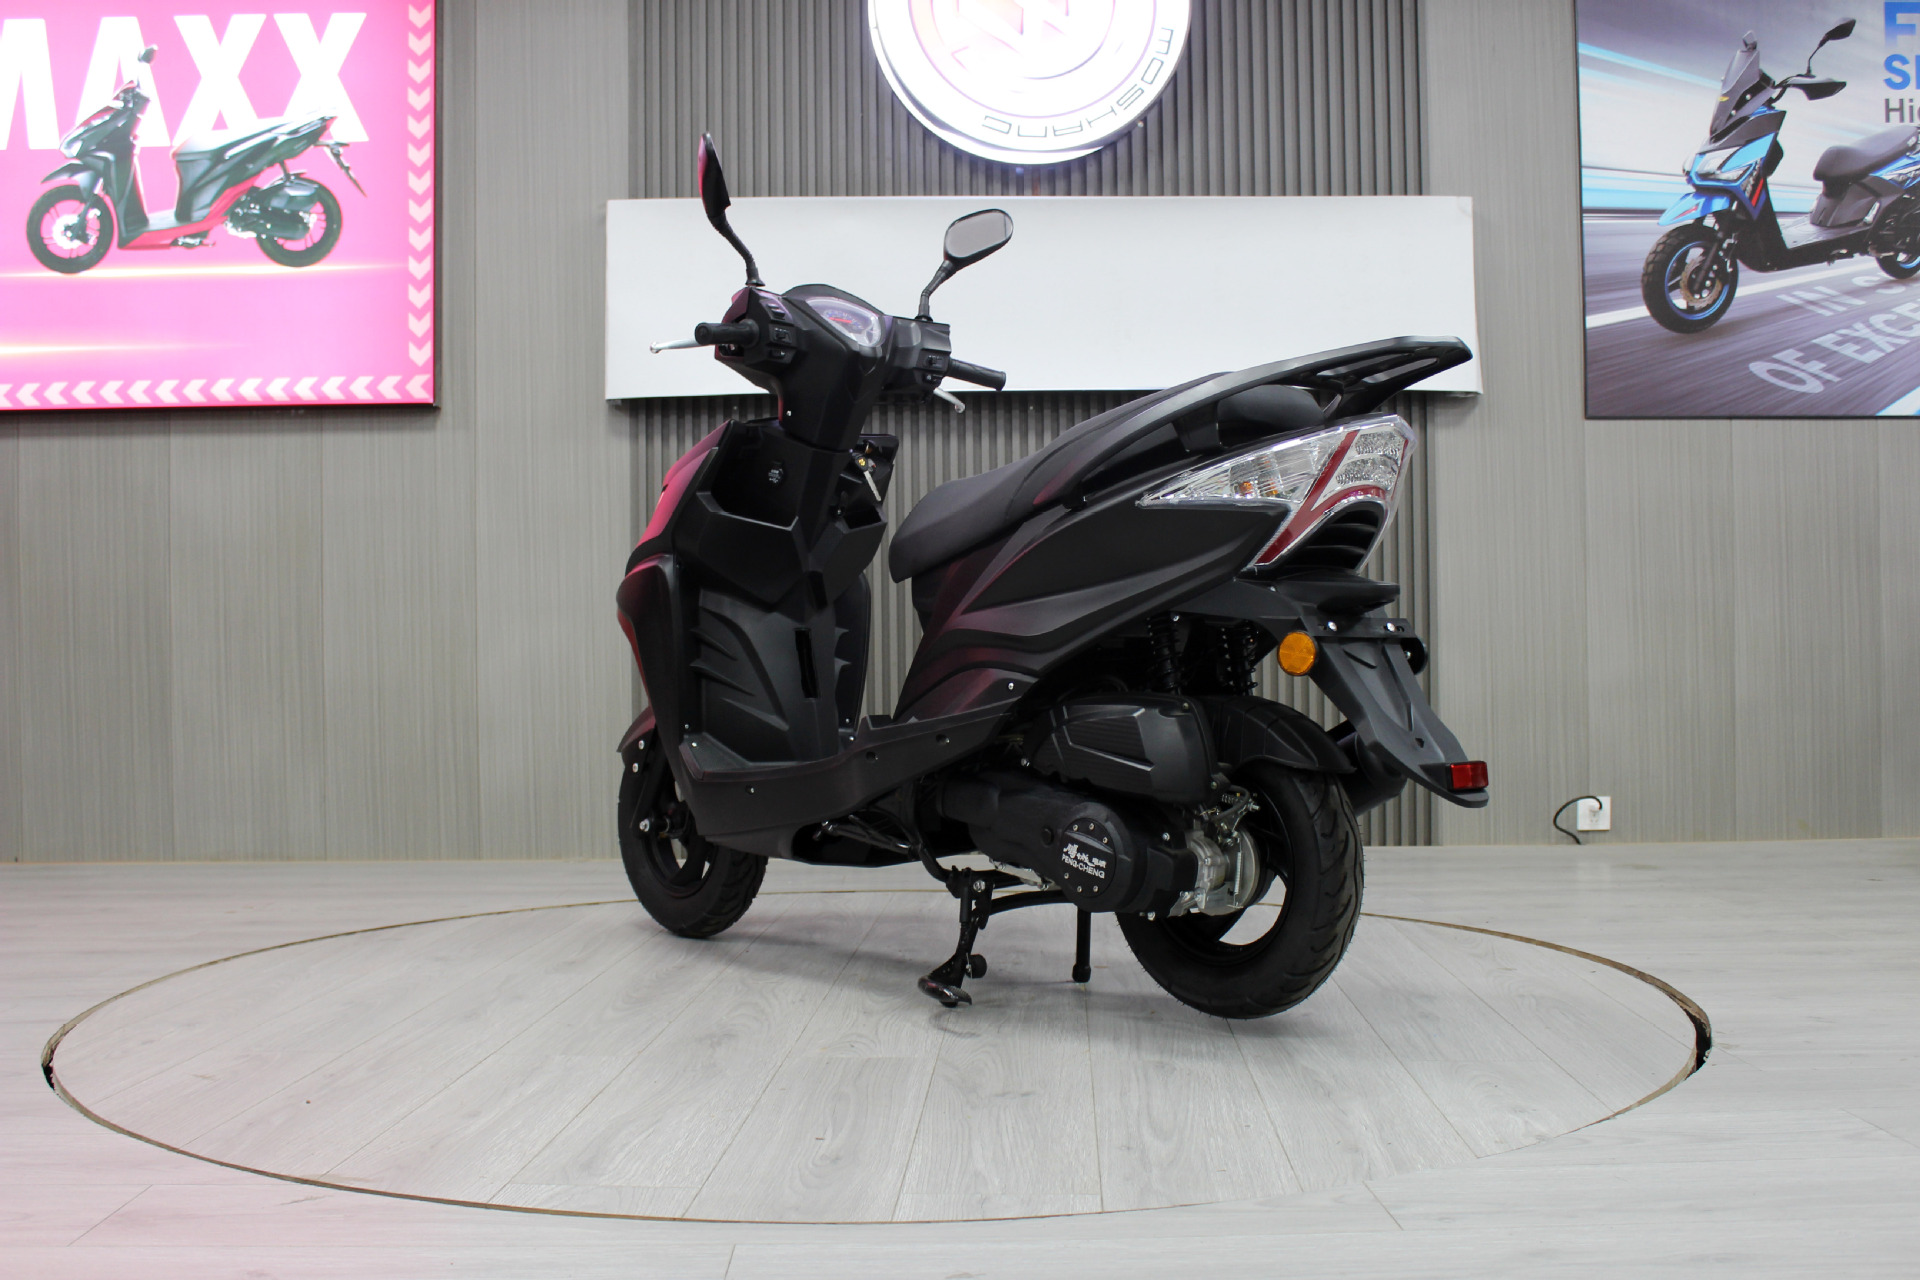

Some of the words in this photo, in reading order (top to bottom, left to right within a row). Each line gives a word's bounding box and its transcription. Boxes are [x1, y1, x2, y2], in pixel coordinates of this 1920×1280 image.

[1883, 54, 1920, 91] S
[1884, 98, 1920, 123] Hi
[1776, 286, 1866, 317] IN
[1748, 349, 1843, 394] OF
